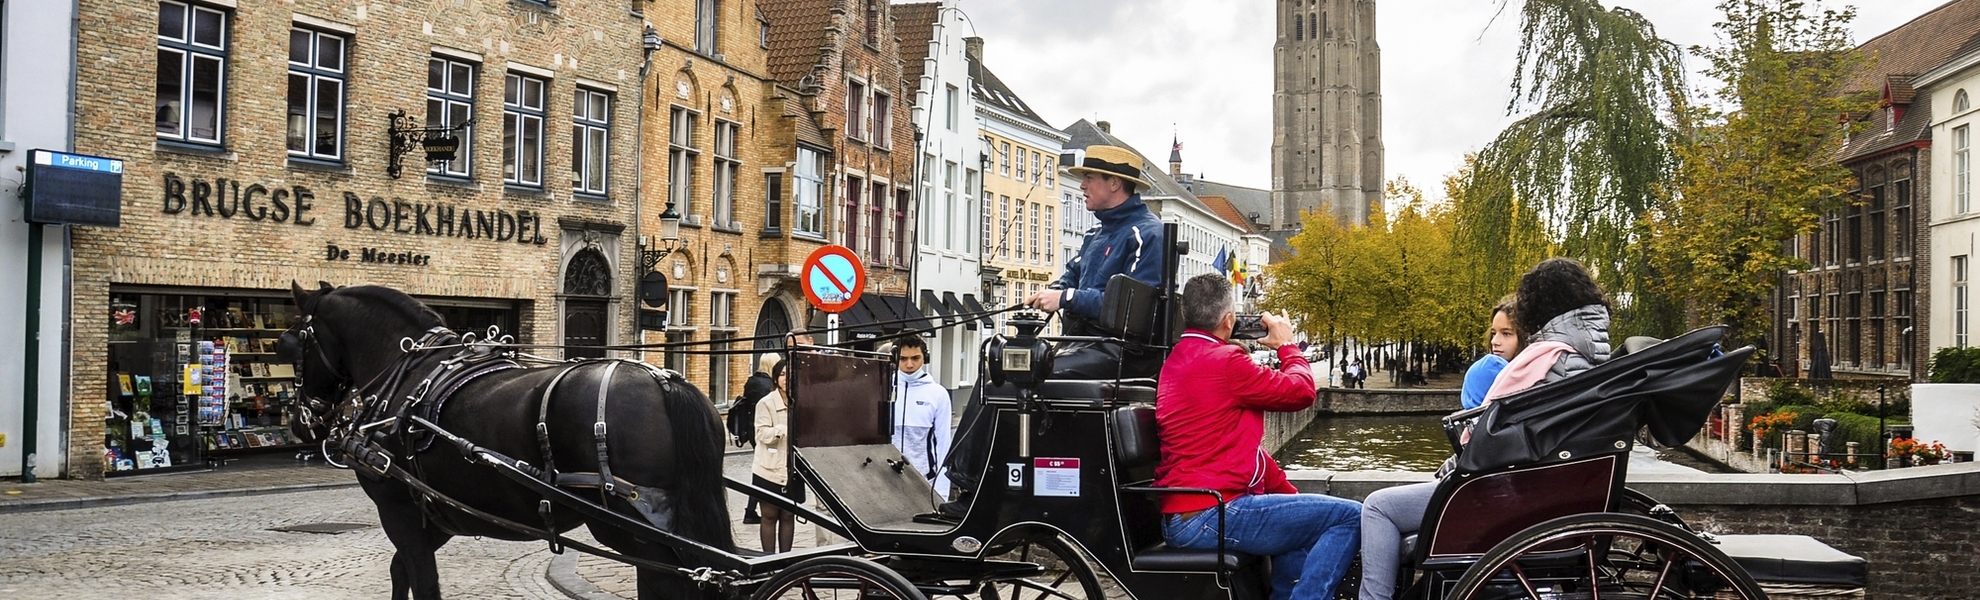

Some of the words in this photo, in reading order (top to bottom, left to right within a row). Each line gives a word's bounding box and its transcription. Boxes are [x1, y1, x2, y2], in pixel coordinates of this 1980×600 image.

[61, 155, 99, 170] Parking
[163, 174, 316, 226] BRUGSE
[344, 193, 549, 245] BOEKHANDEL
[326, 244, 350, 261] De
[361, 247, 431, 267] Meester
[1011, 468, 1021, 482] 9
